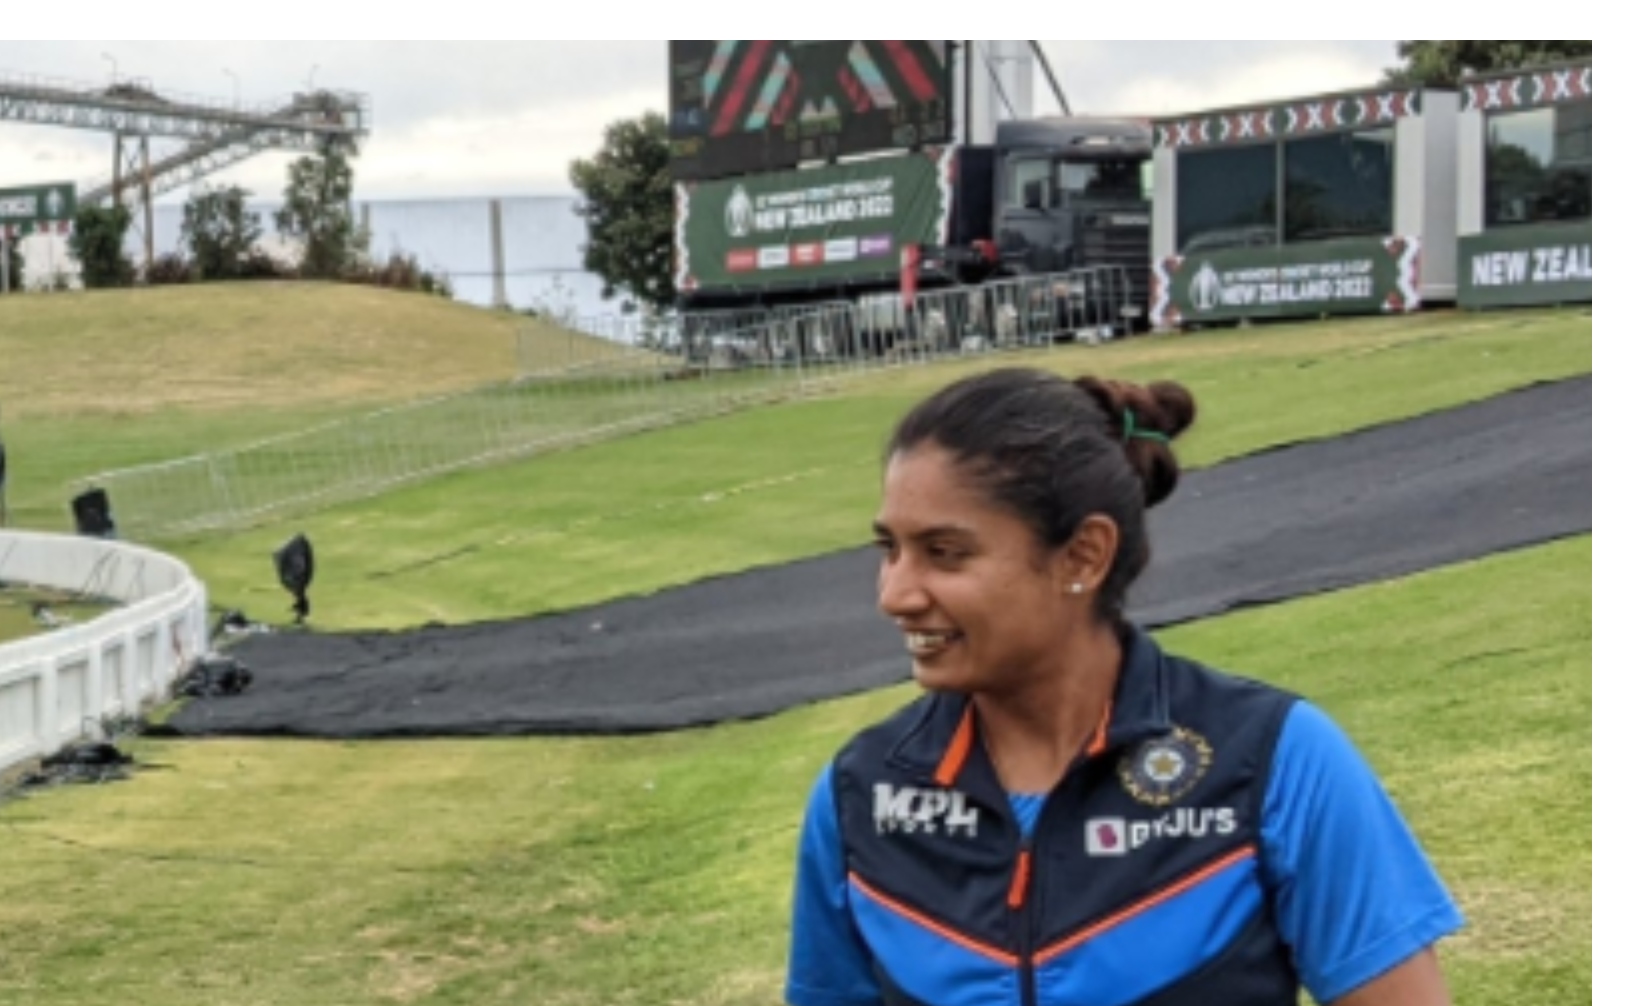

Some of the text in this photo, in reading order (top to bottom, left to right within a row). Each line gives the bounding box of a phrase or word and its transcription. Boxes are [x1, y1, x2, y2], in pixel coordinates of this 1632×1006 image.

[1472, 244, 1592, 286] NEW ZEAL
[1259, 278, 1331, 304] ZEALAND
[873, 783, 978, 825] MPL
